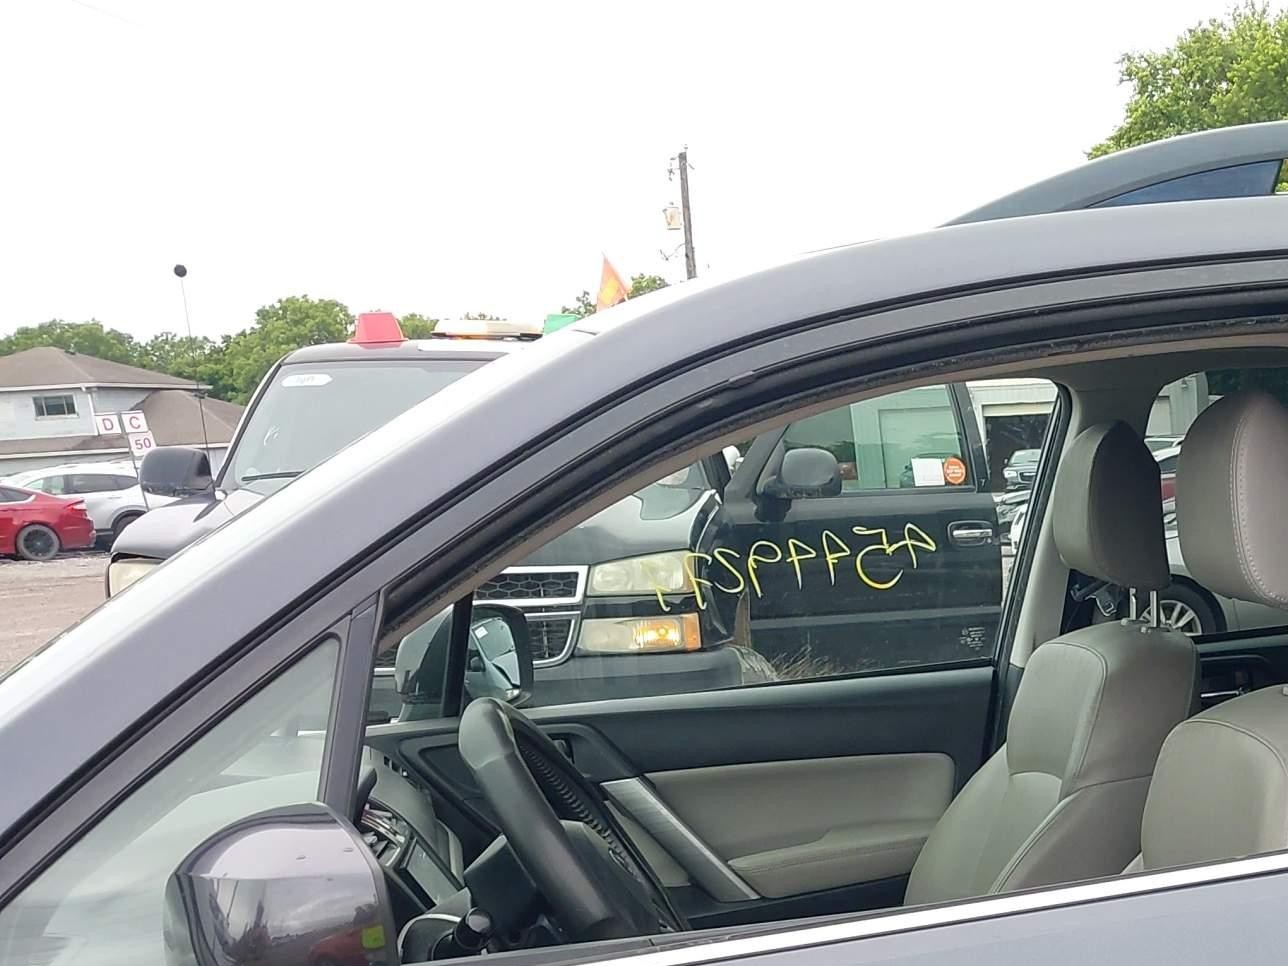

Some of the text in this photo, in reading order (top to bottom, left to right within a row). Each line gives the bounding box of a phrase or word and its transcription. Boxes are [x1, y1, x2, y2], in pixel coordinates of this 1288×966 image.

[102, 417, 114, 431] D
[129, 416, 141, 429] C
[134, 437, 152, 450] 50
